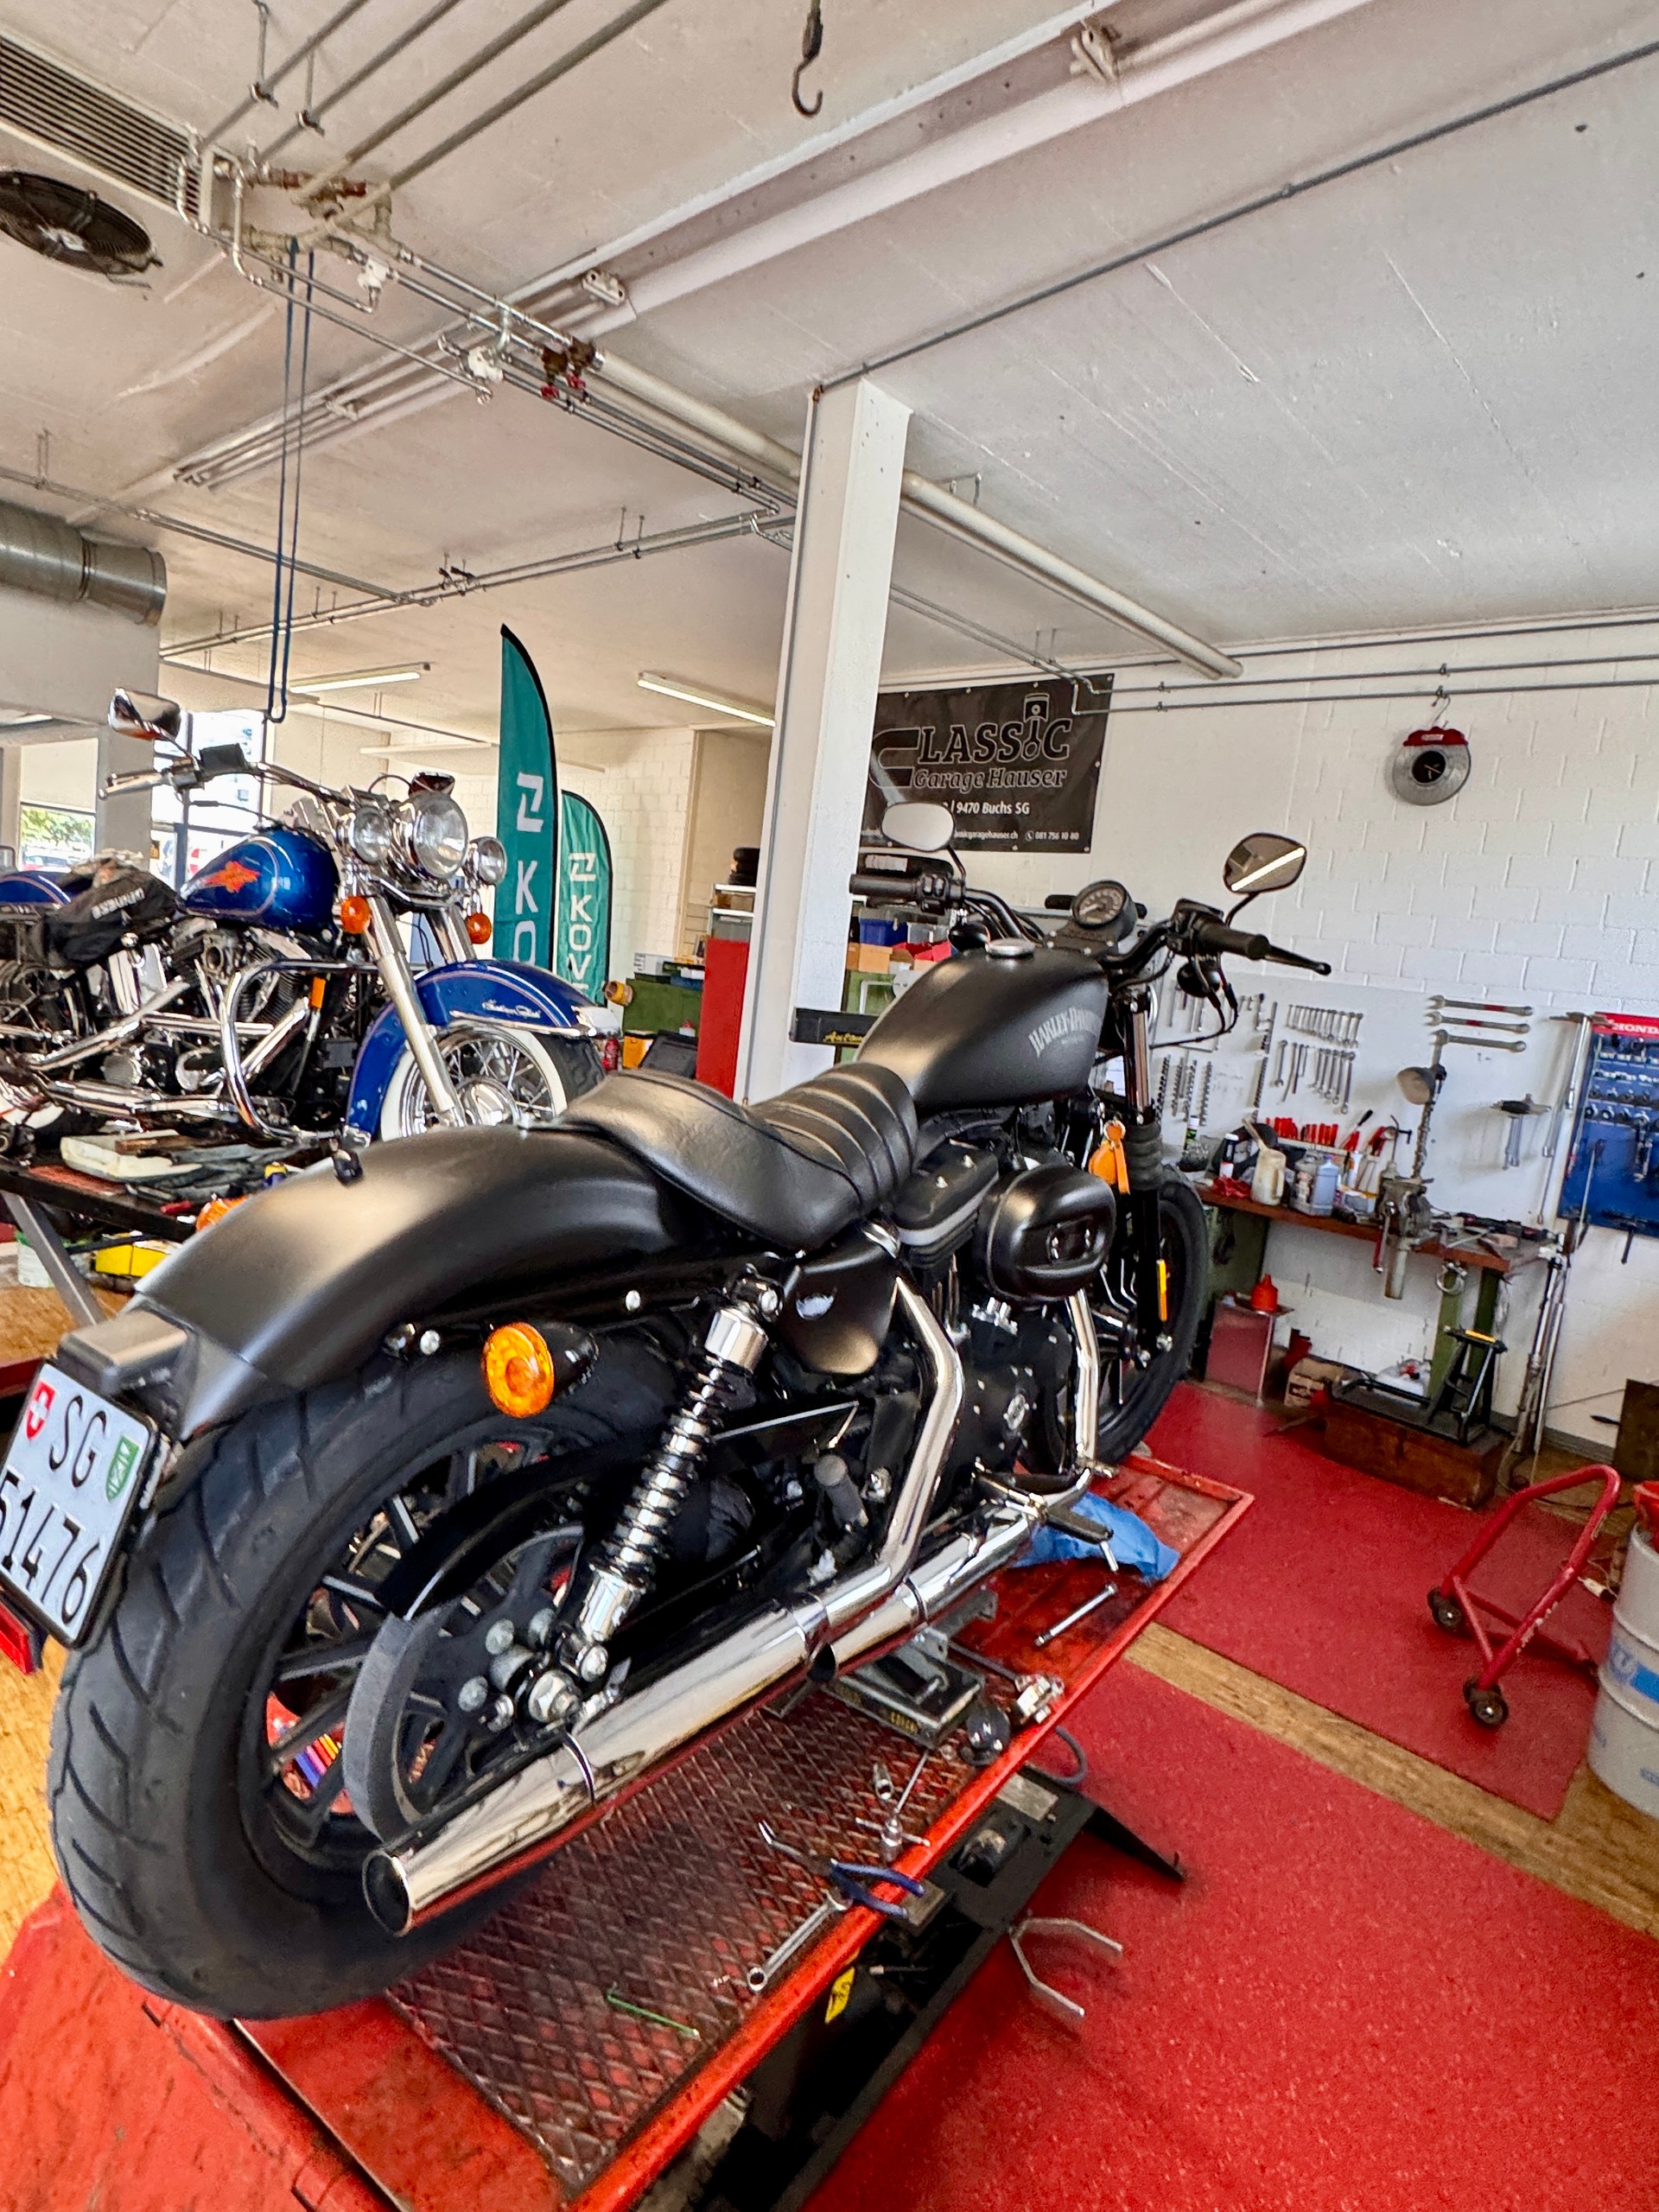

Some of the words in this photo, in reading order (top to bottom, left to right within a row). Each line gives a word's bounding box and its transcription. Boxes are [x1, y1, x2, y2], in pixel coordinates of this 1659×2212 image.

[913, 768, 985, 794] Garage
[987, 767, 1067, 788] Hauser
[956, 802, 980, 815] 9470
[982, 800, 1013, 815] Buchs
[1014, 801, 1030, 815] SG
[568, 893, 593, 990] KOV
[1612, 1022, 1659, 1034] HOND
[48, 1395, 107, 1489] SG
[0, 1469, 101, 1625] 51476
